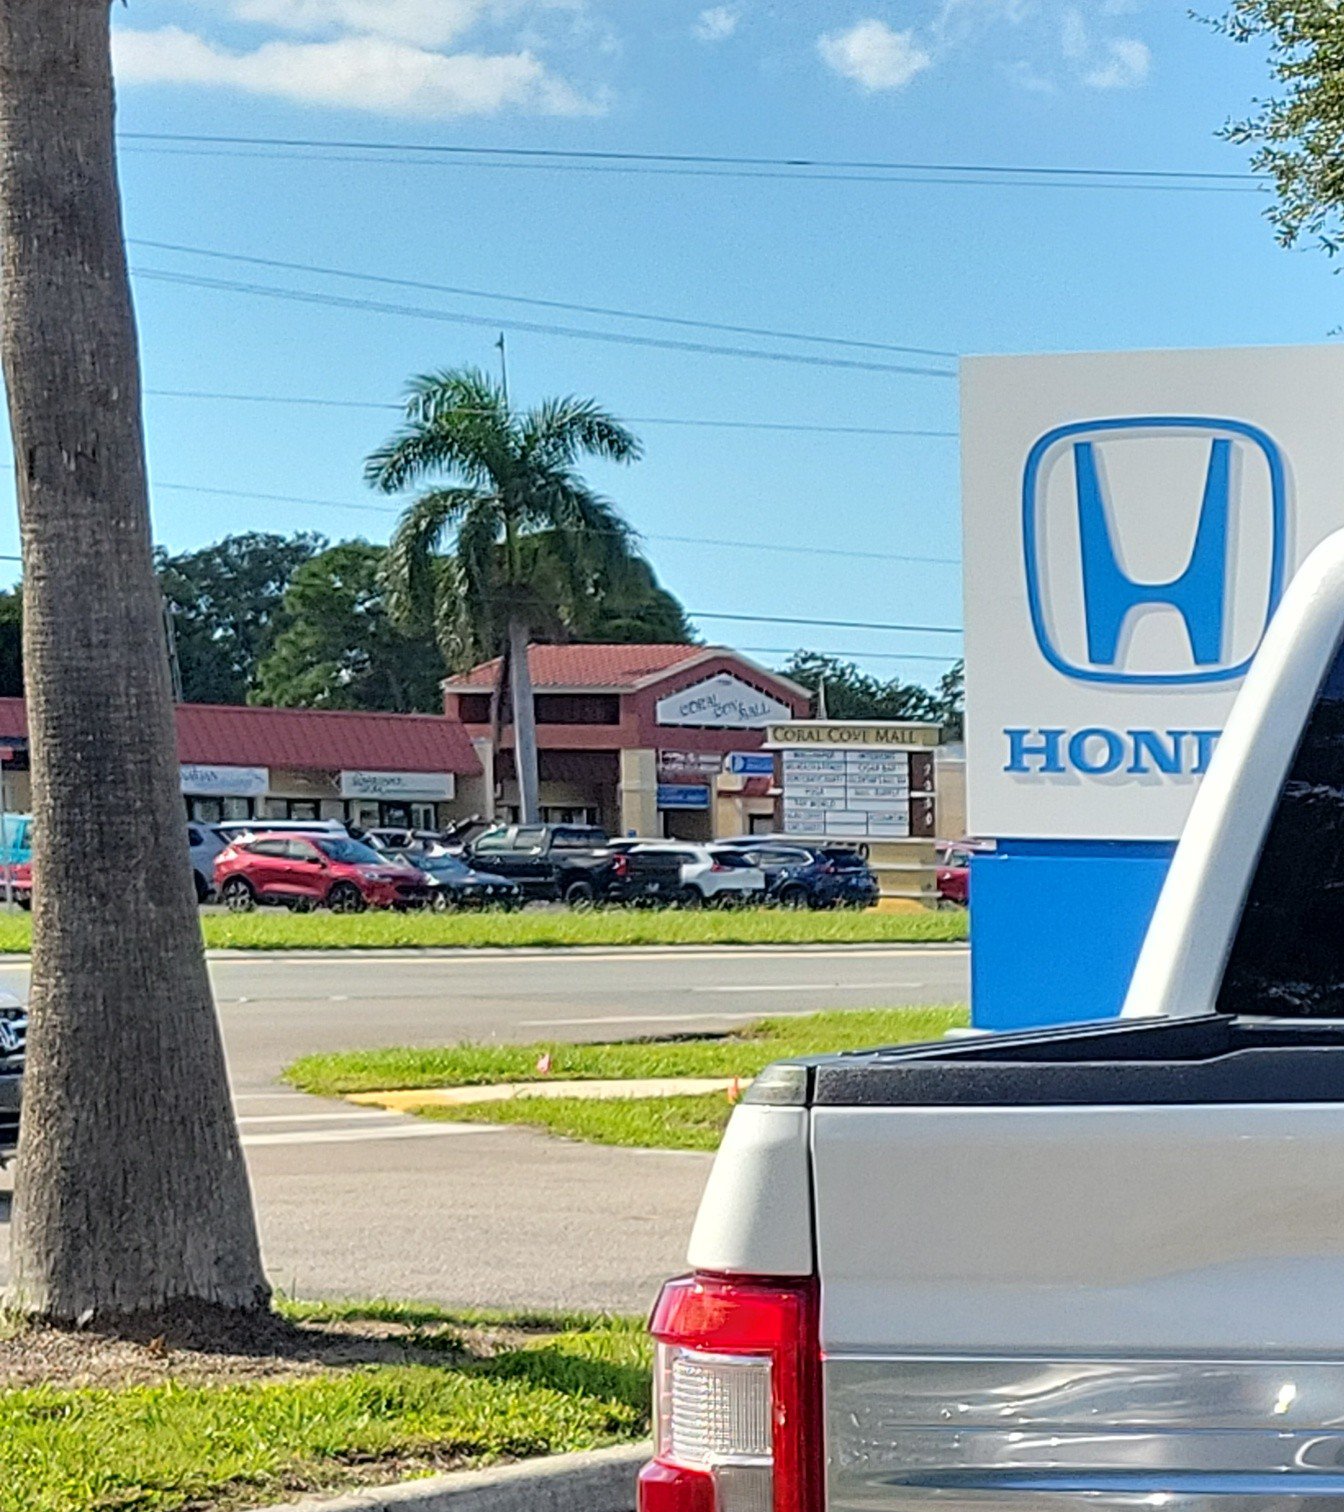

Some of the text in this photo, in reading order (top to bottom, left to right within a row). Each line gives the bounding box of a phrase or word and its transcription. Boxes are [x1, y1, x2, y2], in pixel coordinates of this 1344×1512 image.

[773, 726, 825, 742] CORAL
[875, 729, 917, 744] MALL
[1003, 728, 1223, 774] HON
